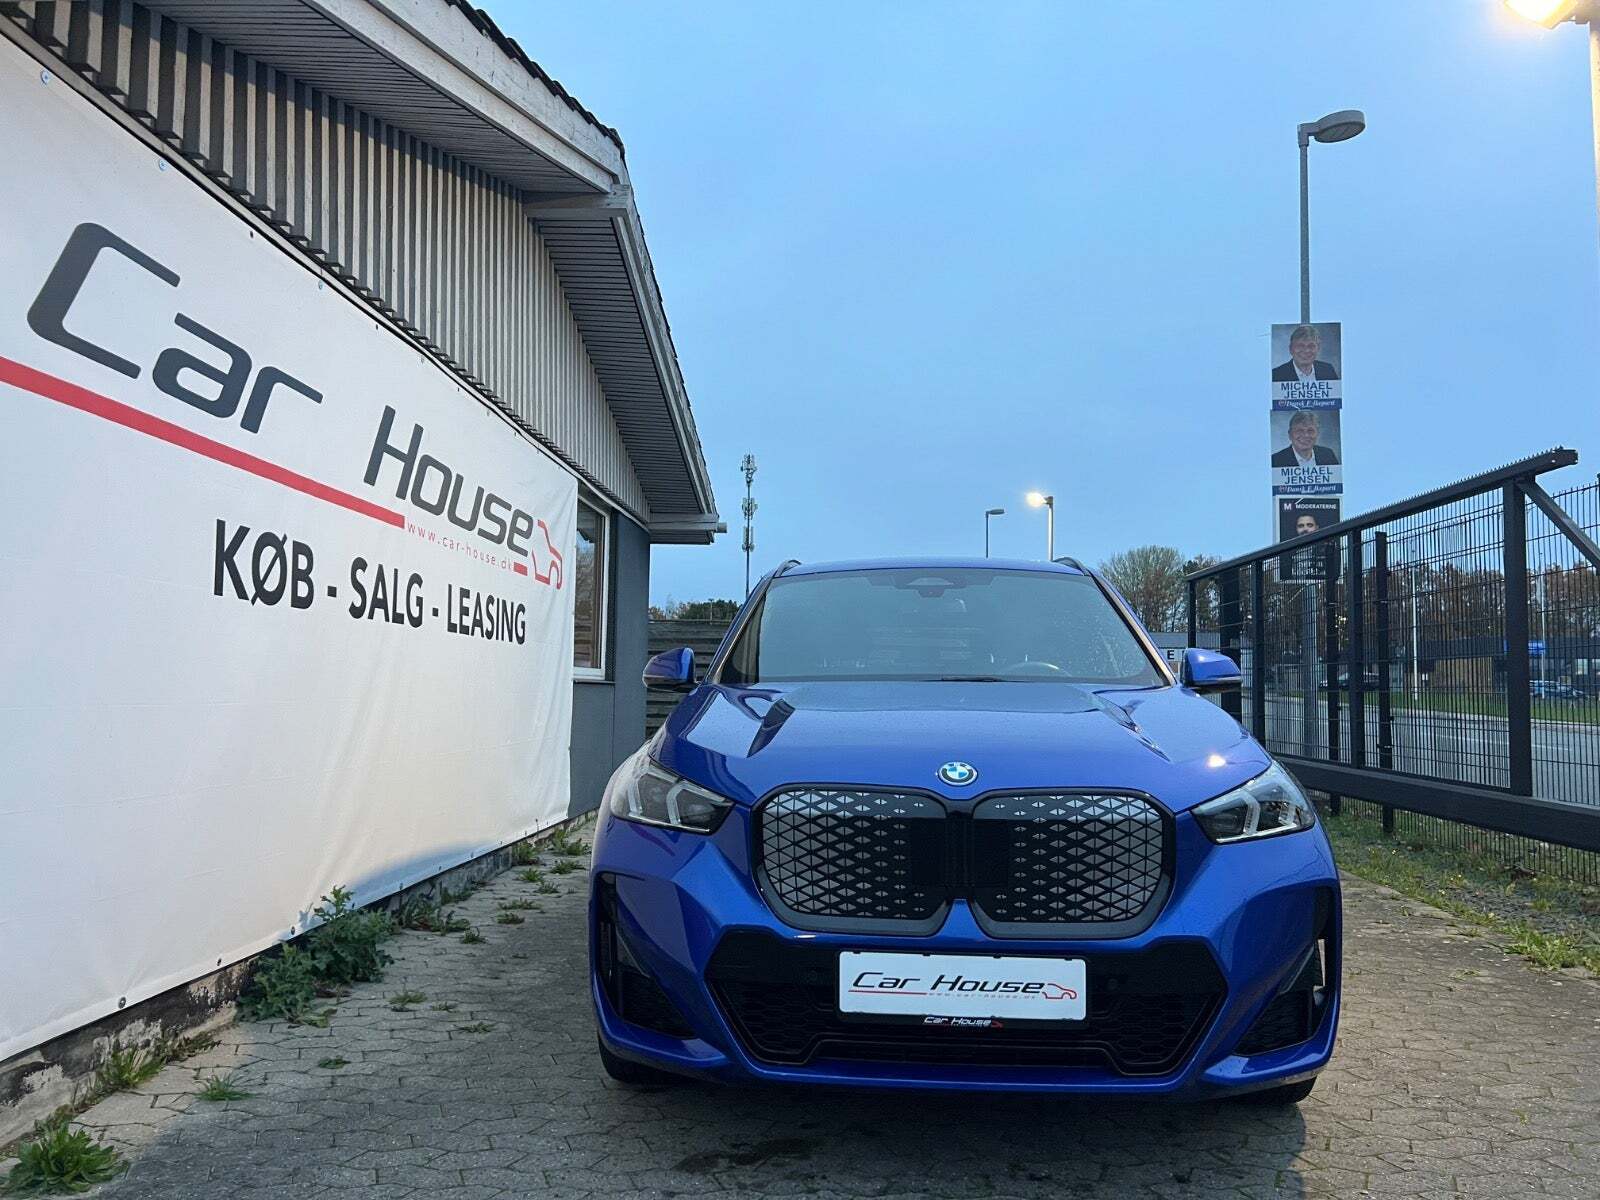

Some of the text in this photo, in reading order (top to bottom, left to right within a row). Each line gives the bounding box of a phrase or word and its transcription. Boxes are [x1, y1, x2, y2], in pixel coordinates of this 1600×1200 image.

[27, 222, 534, 558] Car House
[1281, 381, 1333, 391] MICHAEL
[1284, 390, 1329, 399] JENSEN
[1281, 466, 1333, 476] MICHAEL
[1285, 475, 1330, 484] JENSEN
[1284, 503, 1292, 511] M
[407, 520, 513, 570] www.car-house.dk
[214, 518, 315, 610] KØB
[348, 556, 424, 629] SALG
[447, 583, 526, 645] LEASING
[853, 971, 1045, 994] Car House
[924, 1016, 992, 1027] Car House
